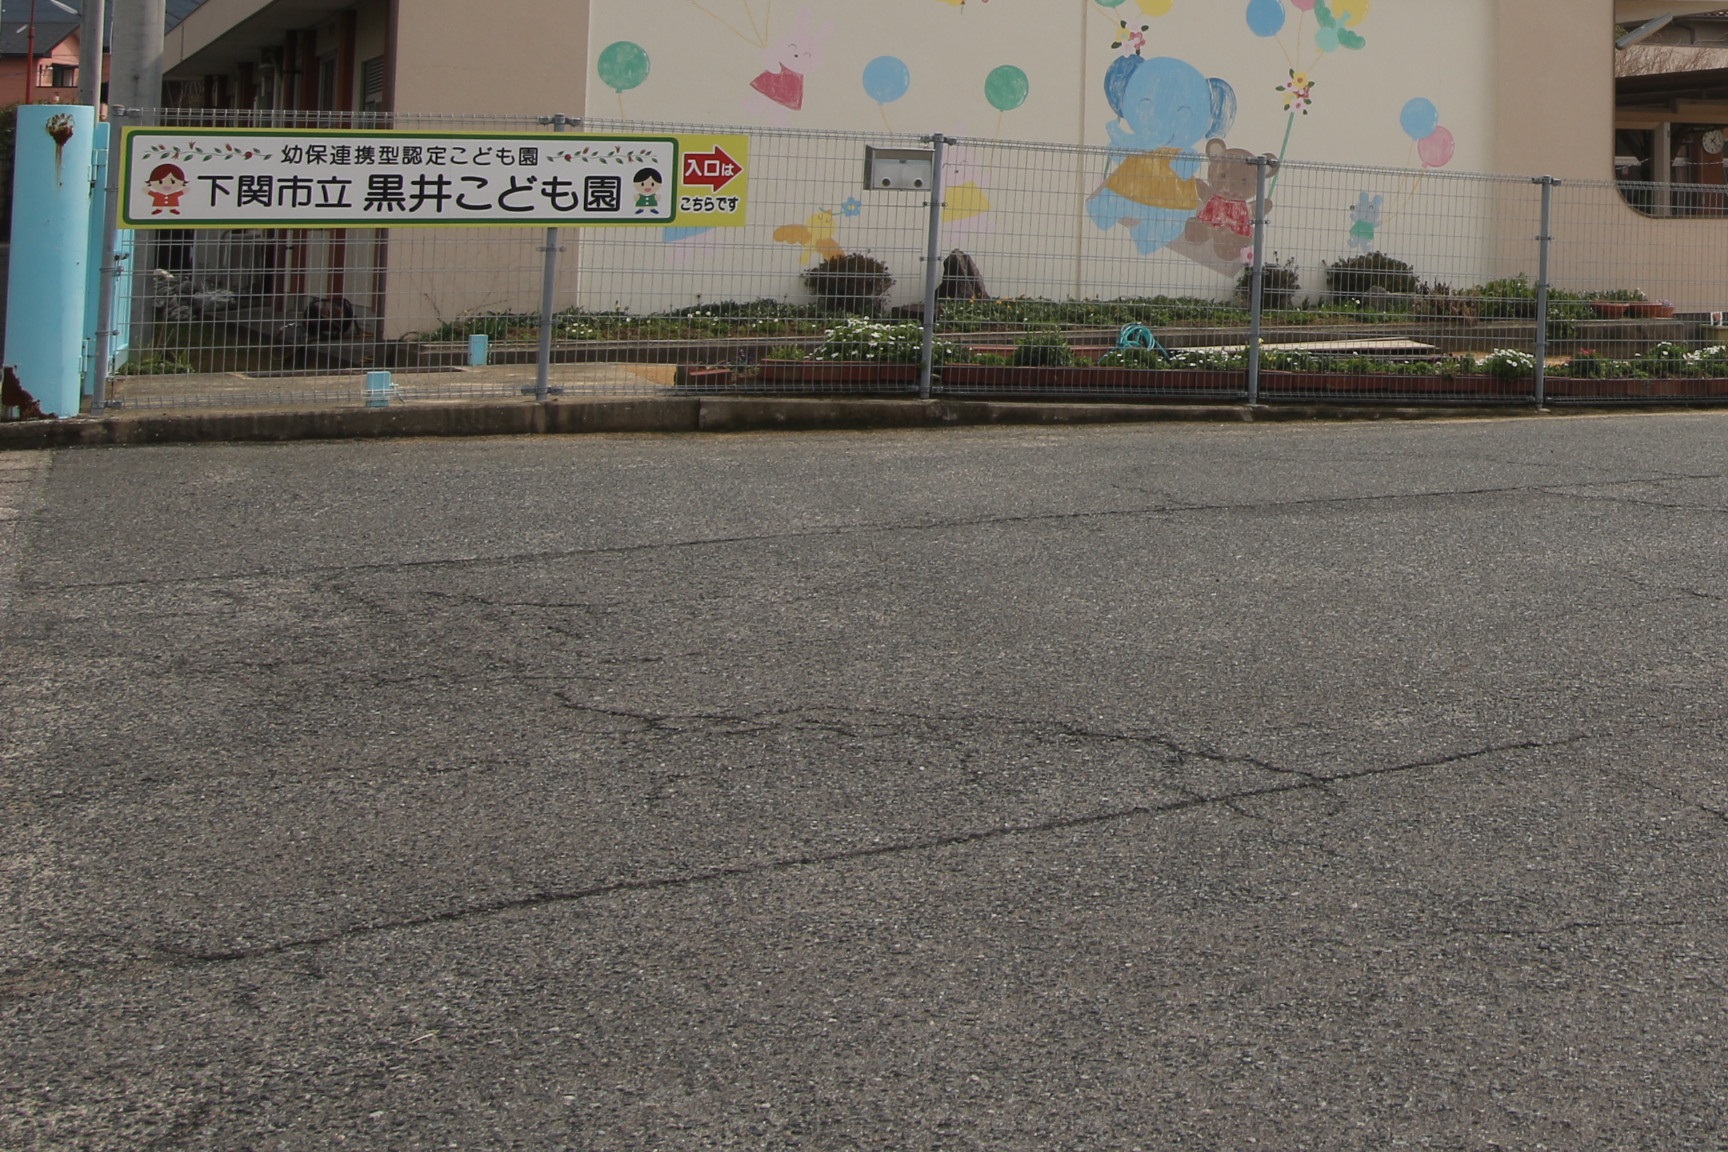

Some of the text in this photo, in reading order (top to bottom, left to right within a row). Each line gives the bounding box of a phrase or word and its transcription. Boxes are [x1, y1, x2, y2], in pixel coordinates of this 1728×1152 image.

[280, 144, 539, 167] 幼保連携型認定こども園
[684, 159, 735, 177] 入口は
[196, 173, 622, 214] 下関市立 黒井こども園
[680, 196, 739, 212] こちらです
